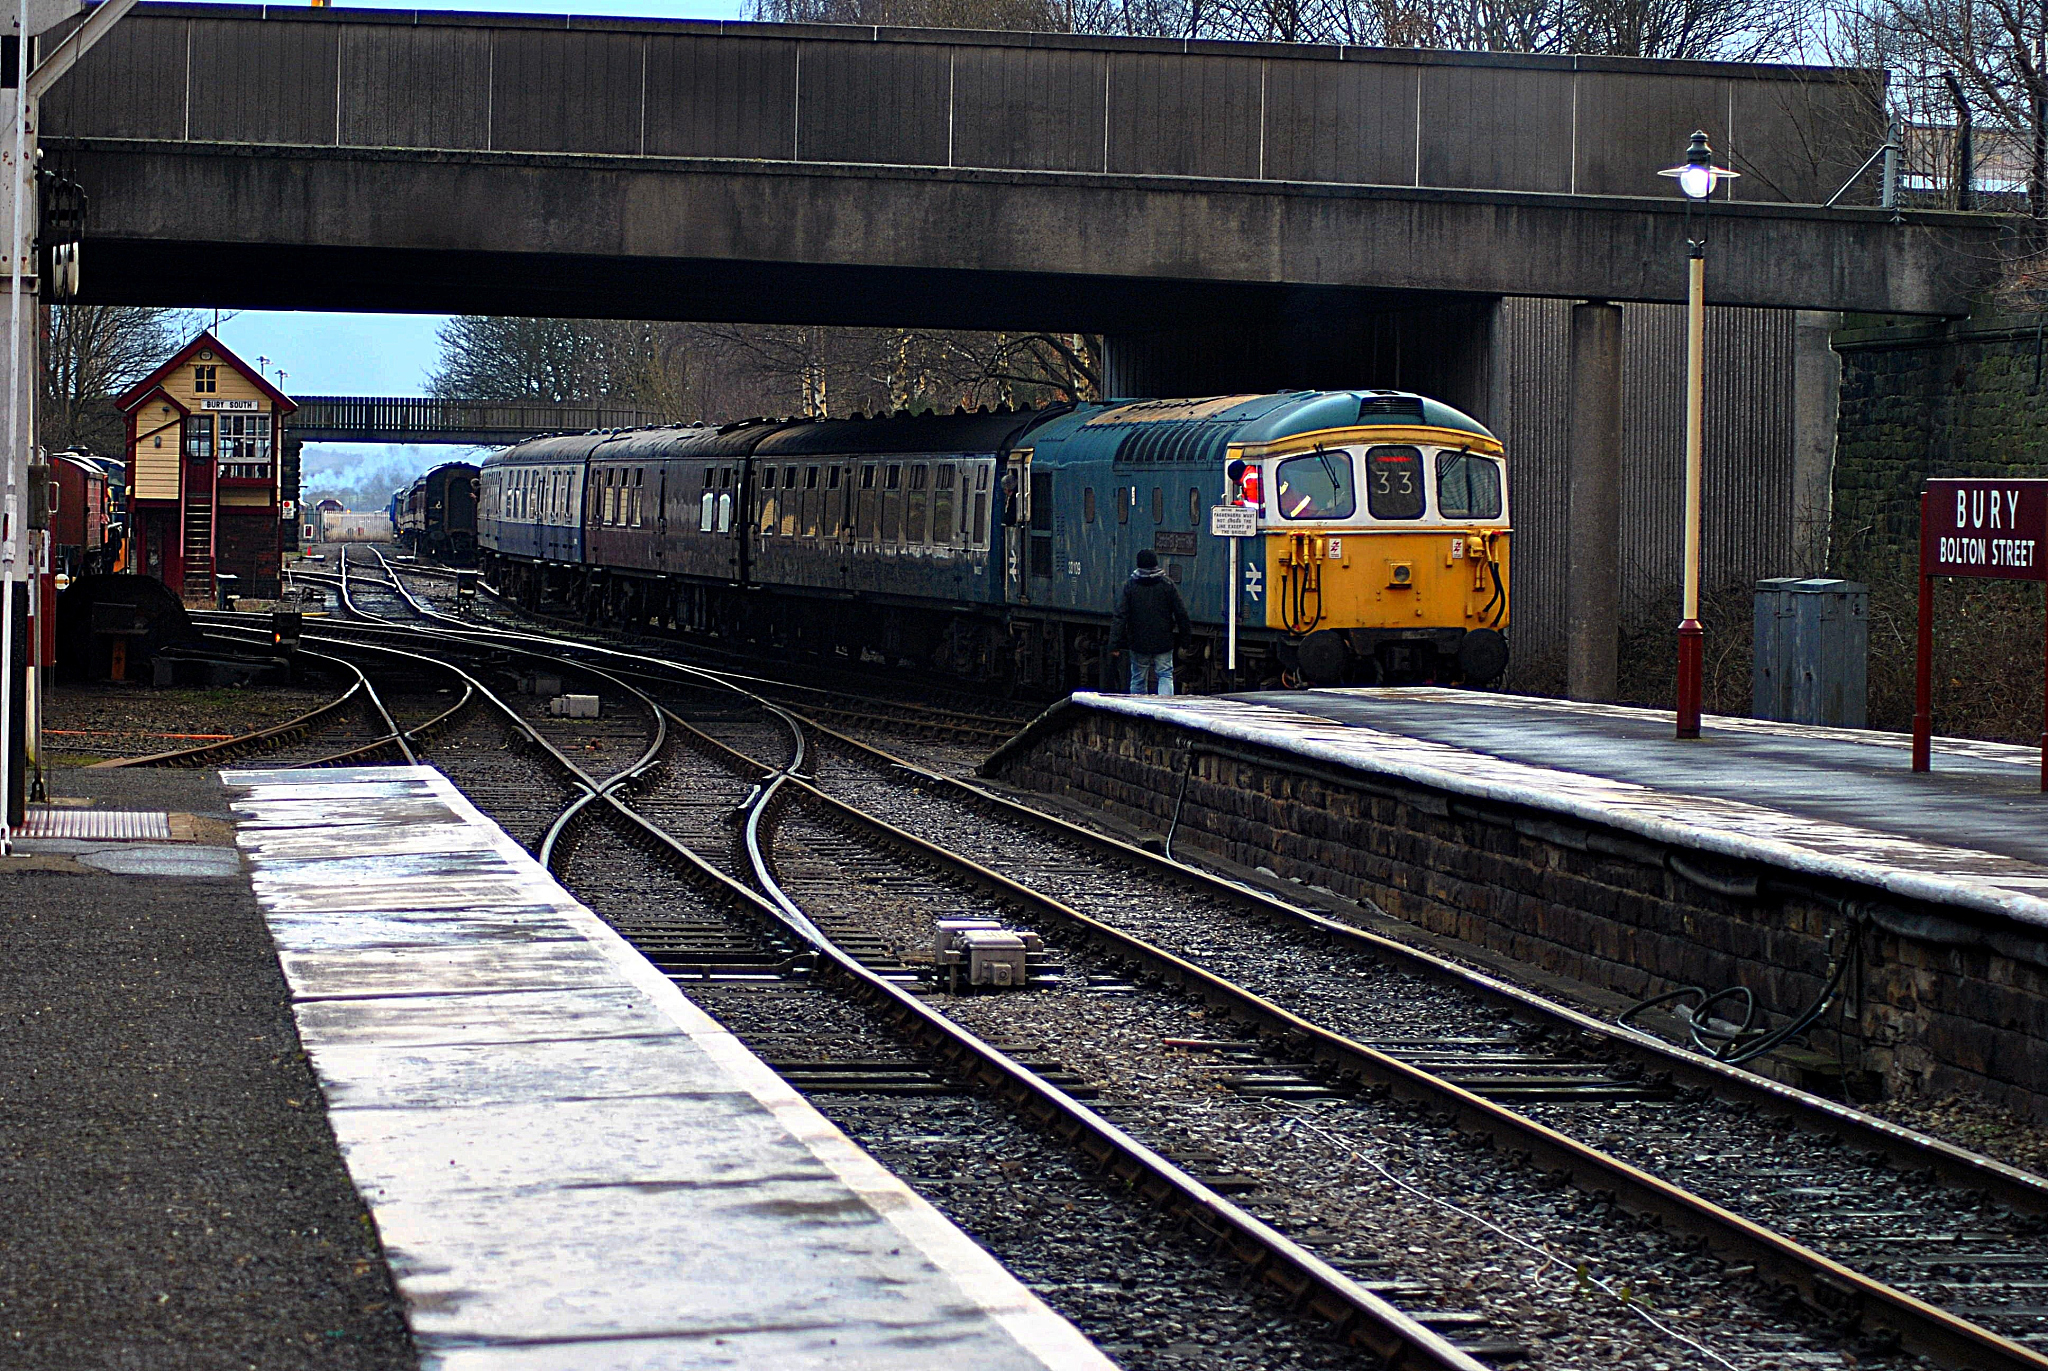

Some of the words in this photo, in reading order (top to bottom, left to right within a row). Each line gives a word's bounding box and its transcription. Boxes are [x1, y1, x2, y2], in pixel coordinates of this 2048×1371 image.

[1957, 489, 2019, 529] BURY
[1940, 537, 1986, 565] BOLTON
[1992, 539, 2035, 567] STREET
